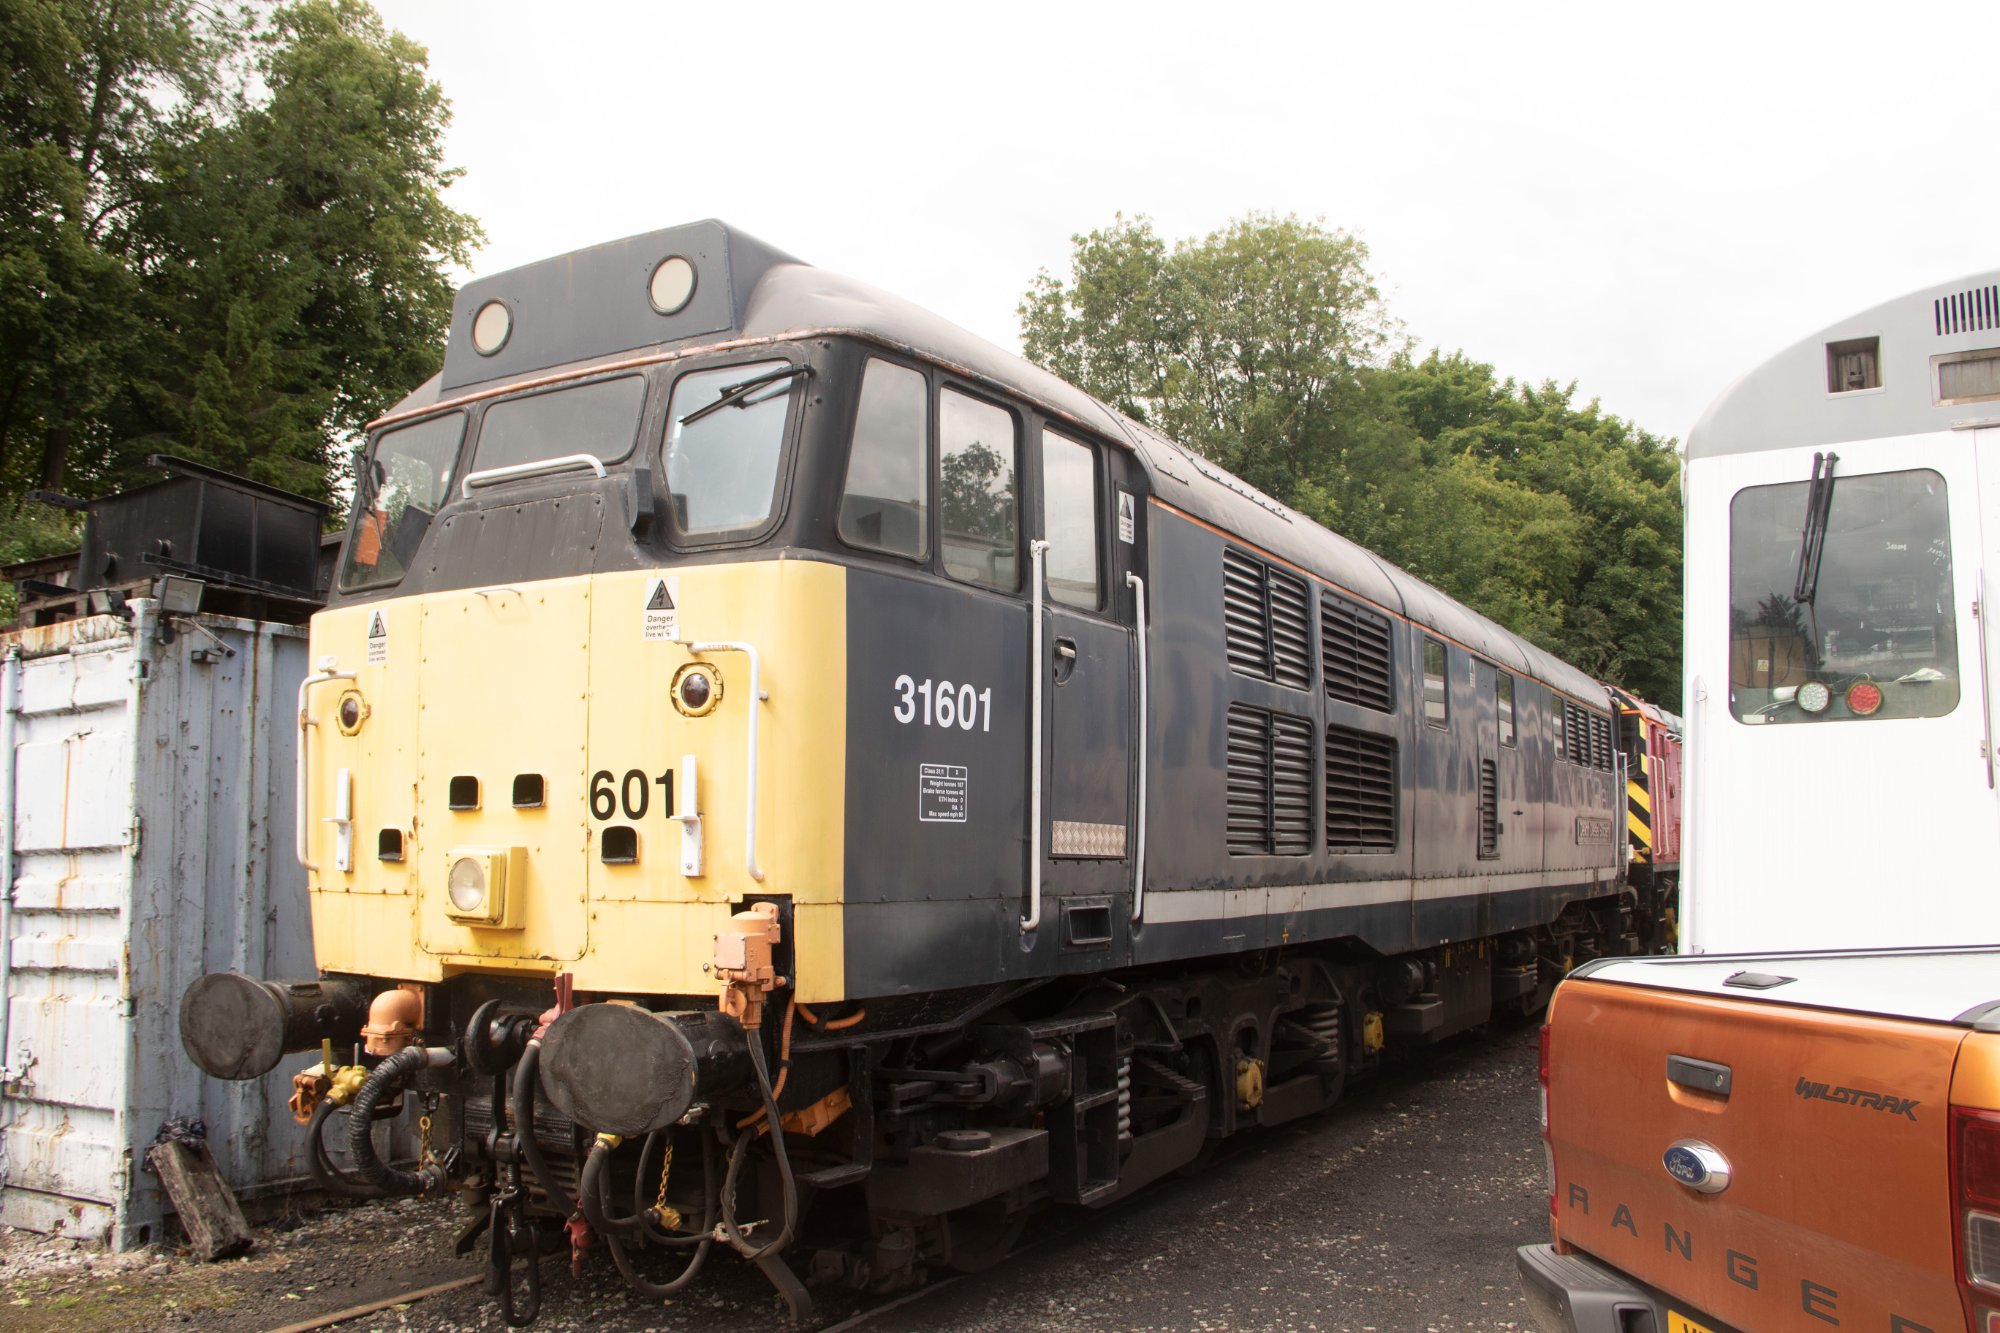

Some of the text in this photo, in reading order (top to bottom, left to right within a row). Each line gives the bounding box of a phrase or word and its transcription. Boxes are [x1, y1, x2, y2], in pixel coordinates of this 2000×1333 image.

[893, 674, 992, 733] 31601
[589, 768, 675, 821] 601
[1795, 1077, 1921, 1122] WILDTRAK
[1668, 1152, 1696, 1180] Ford
